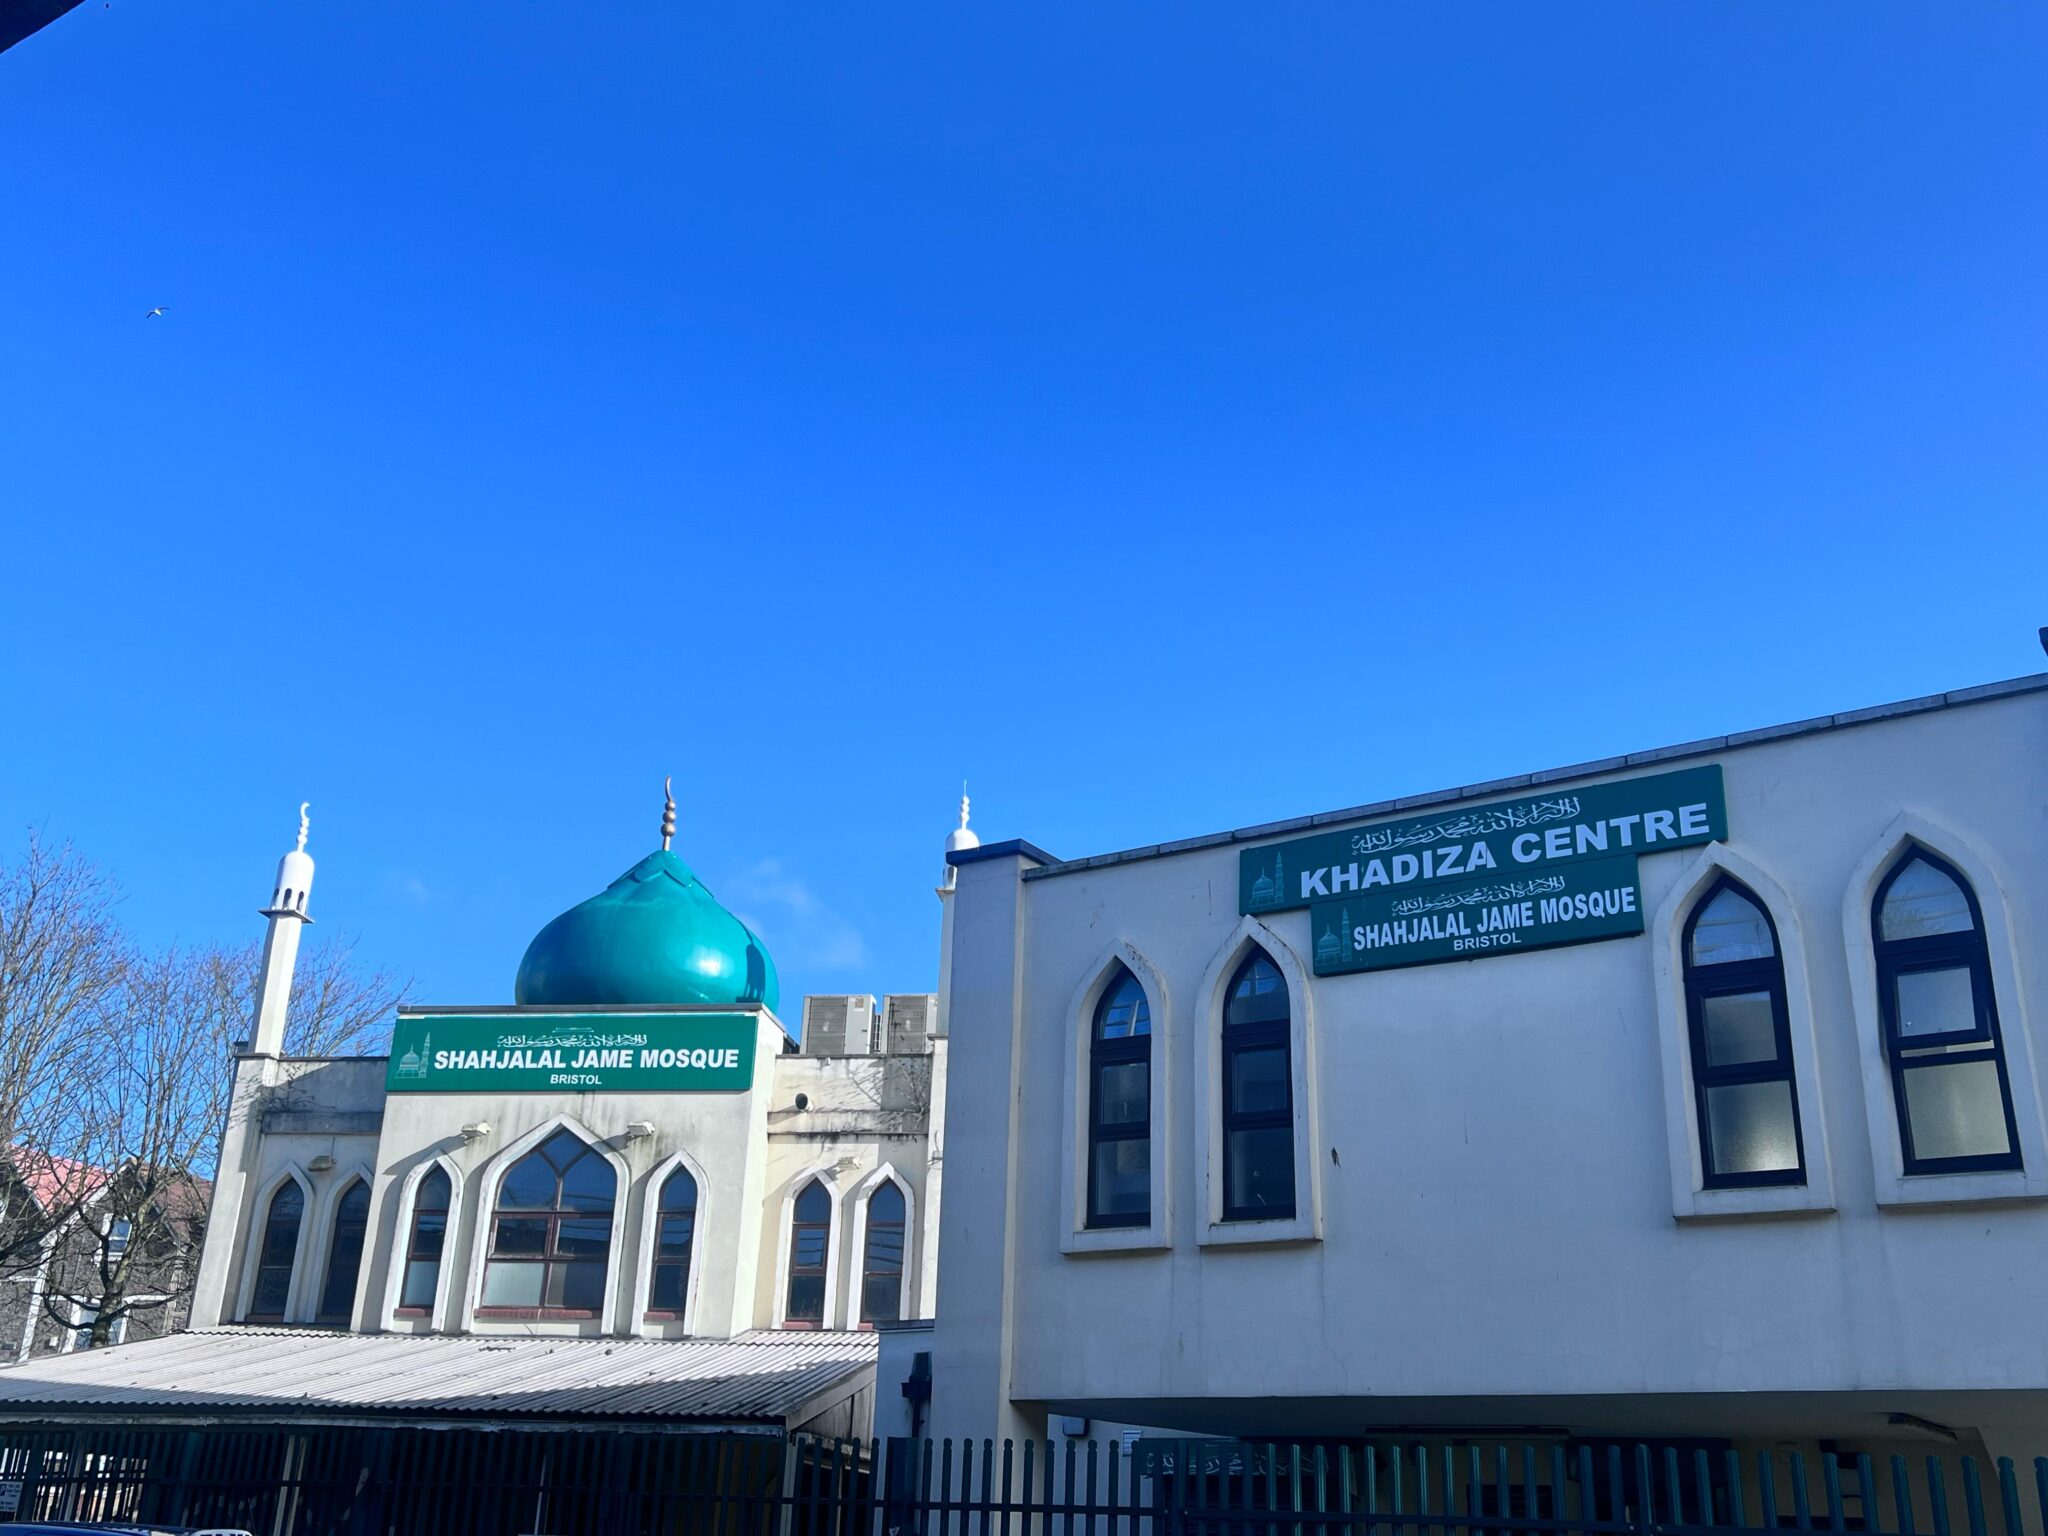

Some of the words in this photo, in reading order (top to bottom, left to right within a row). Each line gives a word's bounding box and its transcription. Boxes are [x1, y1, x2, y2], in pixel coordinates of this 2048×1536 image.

[1300, 841, 1497, 899] KHADIZA
[1511, 802, 1710, 864] CENTRE
[1353, 910, 1471, 951] SHAHJALAL
[1476, 901, 1534, 934] JAME
[1540, 886, 1637, 925] MOSQUE
[1453, 932, 1522, 952] BRISTOL
[434, 1049, 567, 1070] SHAHJALAL
[570, 1049, 634, 1069] JAME
[639, 1048, 739, 1069] MOSQUE
[550, 1074, 602, 1085] BRISTOL
